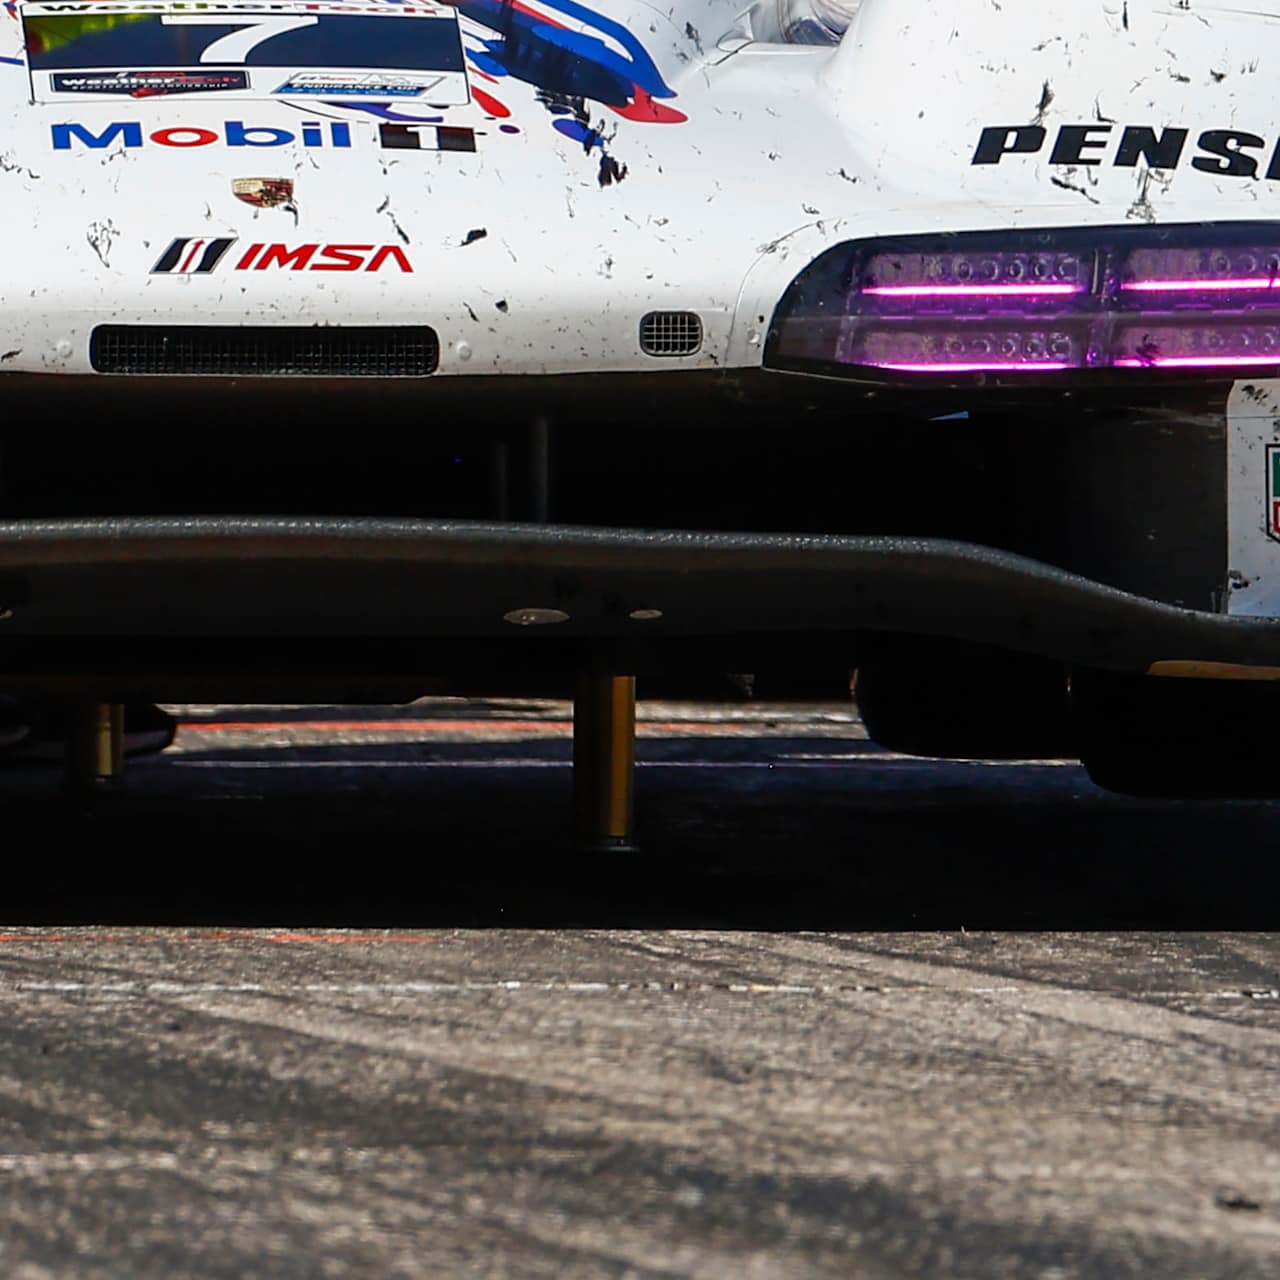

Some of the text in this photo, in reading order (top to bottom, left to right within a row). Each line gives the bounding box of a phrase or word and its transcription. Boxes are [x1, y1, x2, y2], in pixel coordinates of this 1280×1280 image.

[161, 15, 320, 64] 7
[51, 121, 352, 150] Mobil
[234, 242, 415, 273] IMSA
